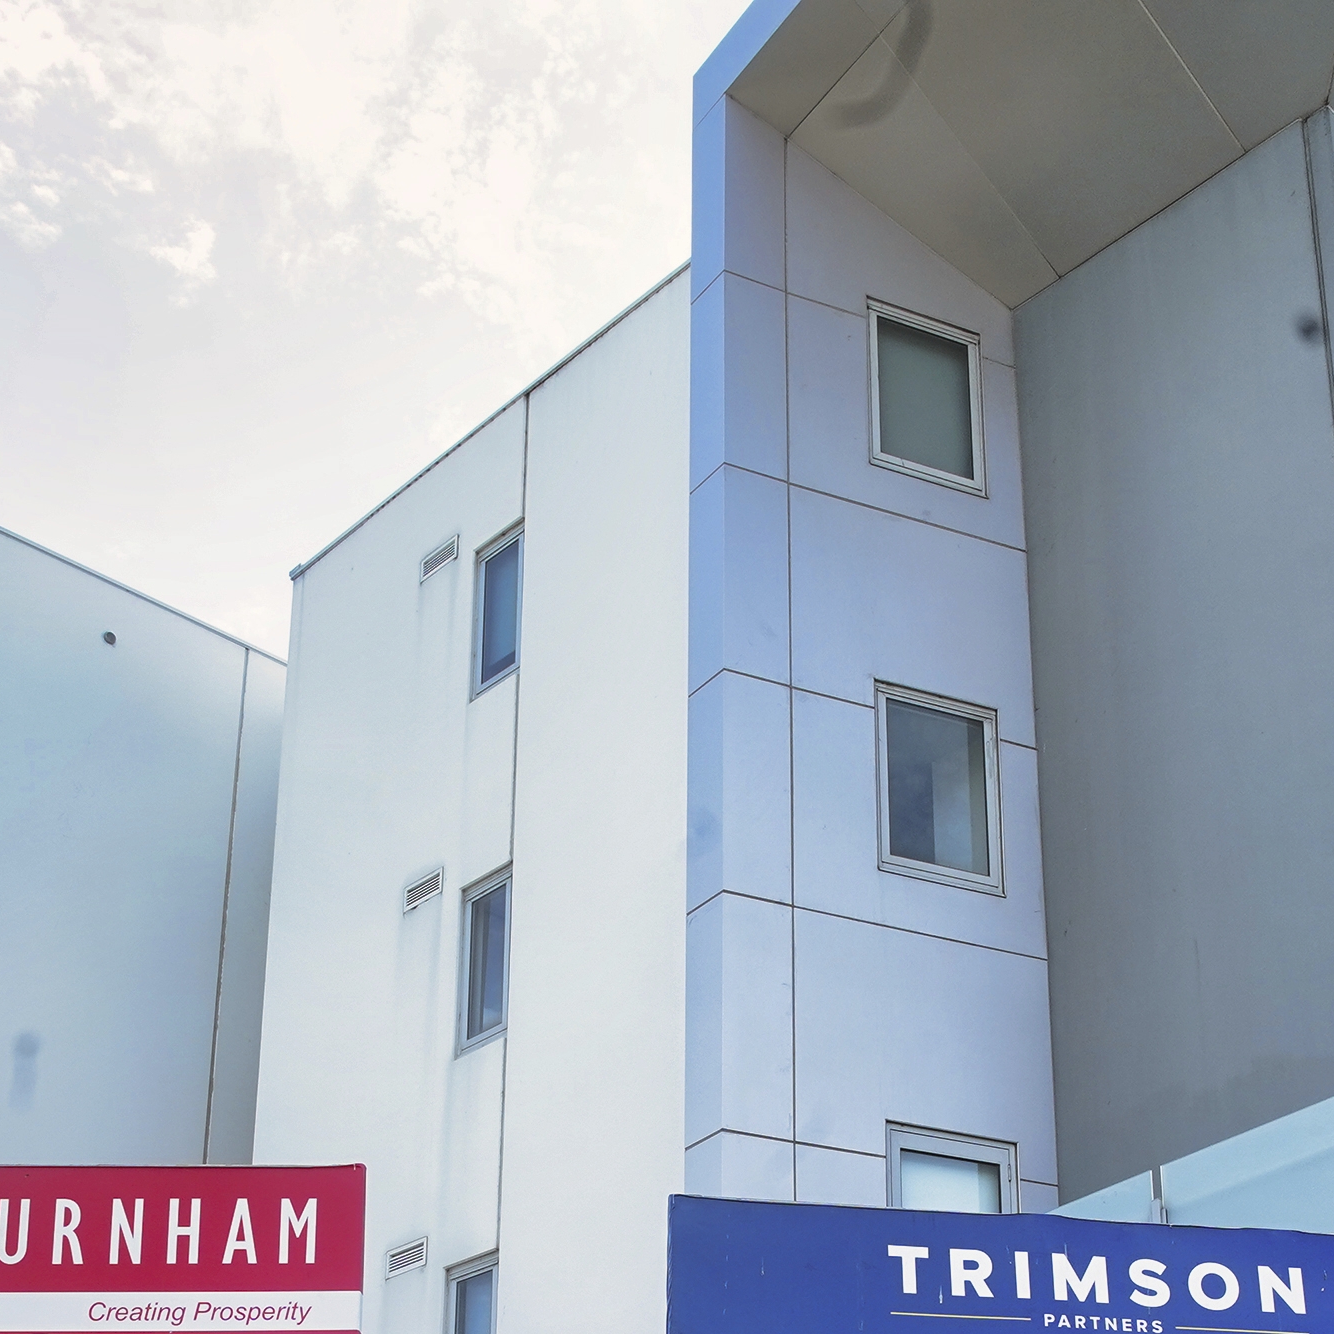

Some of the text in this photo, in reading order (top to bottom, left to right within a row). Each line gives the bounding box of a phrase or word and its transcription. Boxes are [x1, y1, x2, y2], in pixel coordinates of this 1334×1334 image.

[887, 1244, 1307, 1315] TRIMSON
[88, 1301, 312, 1326] Creating Prosperity
[1044, 1313, 1163, 1334] PARTNERS
